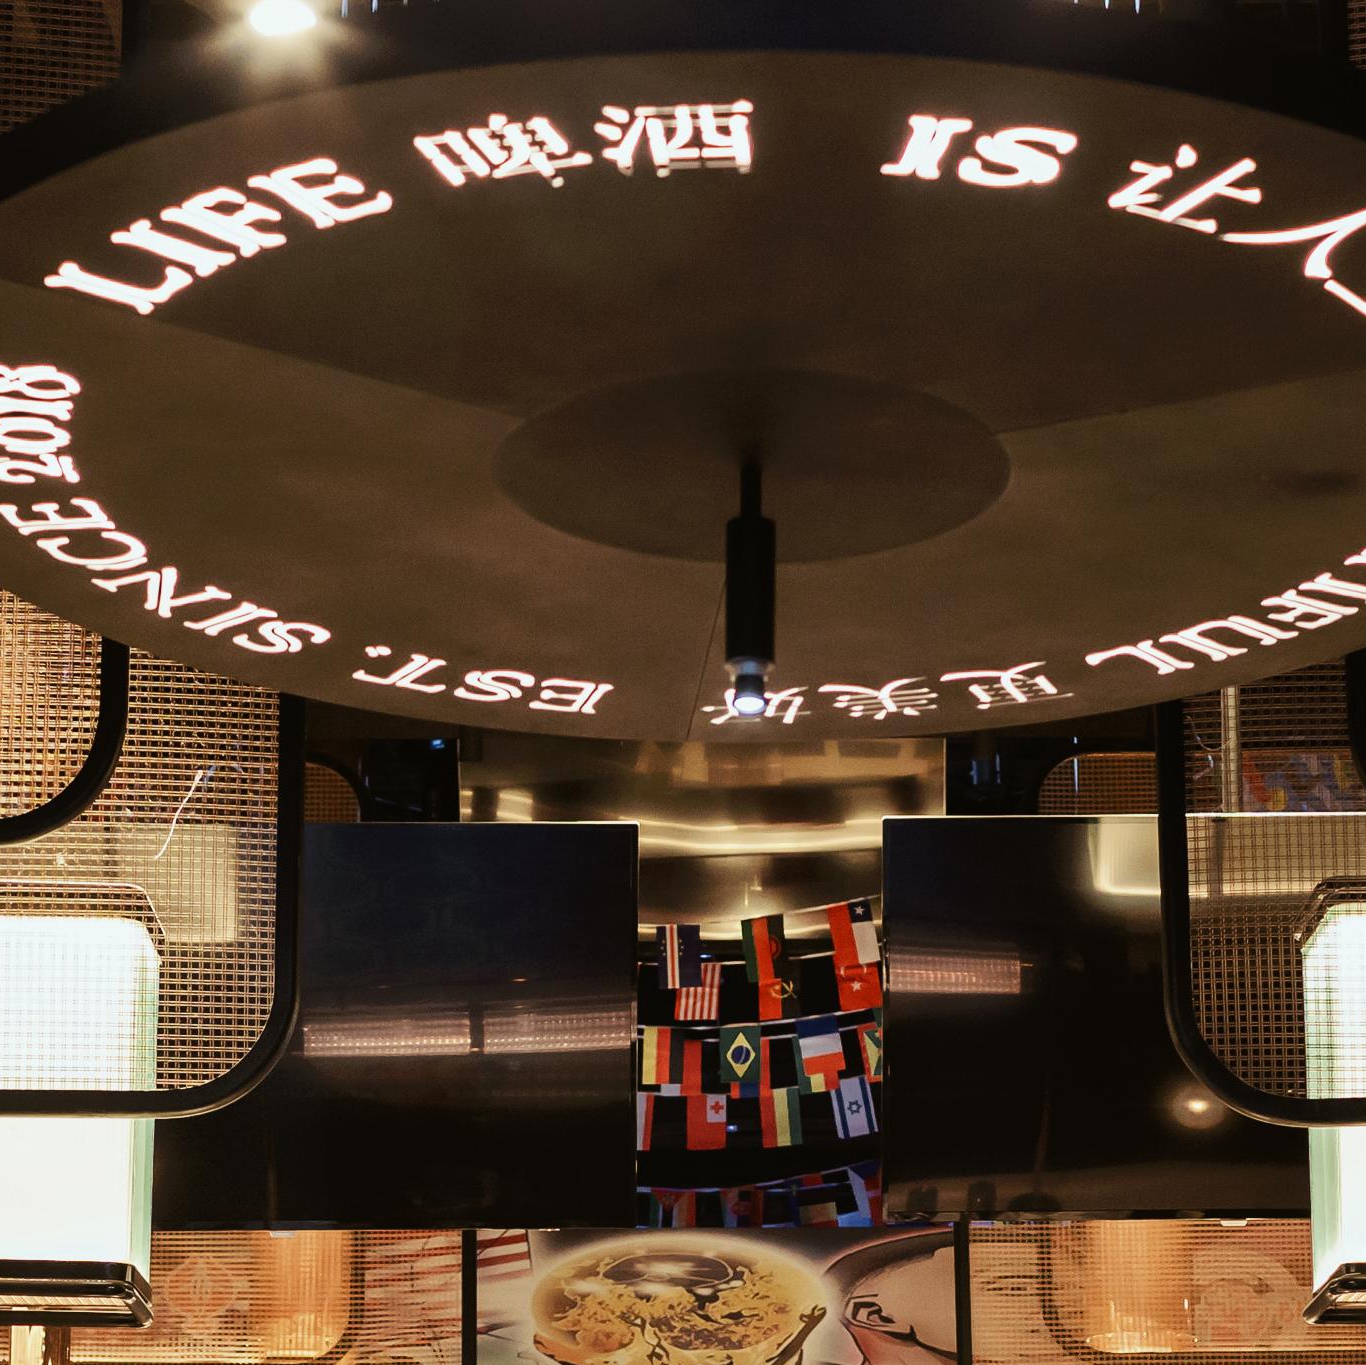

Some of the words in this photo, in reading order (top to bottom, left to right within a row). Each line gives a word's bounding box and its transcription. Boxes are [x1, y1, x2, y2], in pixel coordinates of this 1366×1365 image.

[44, 157, 393, 315] LIFE
[413, 99, 754, 188] 啤酒
[880, 114, 1078, 188] IS
[352, 645, 614, 714] EST.
